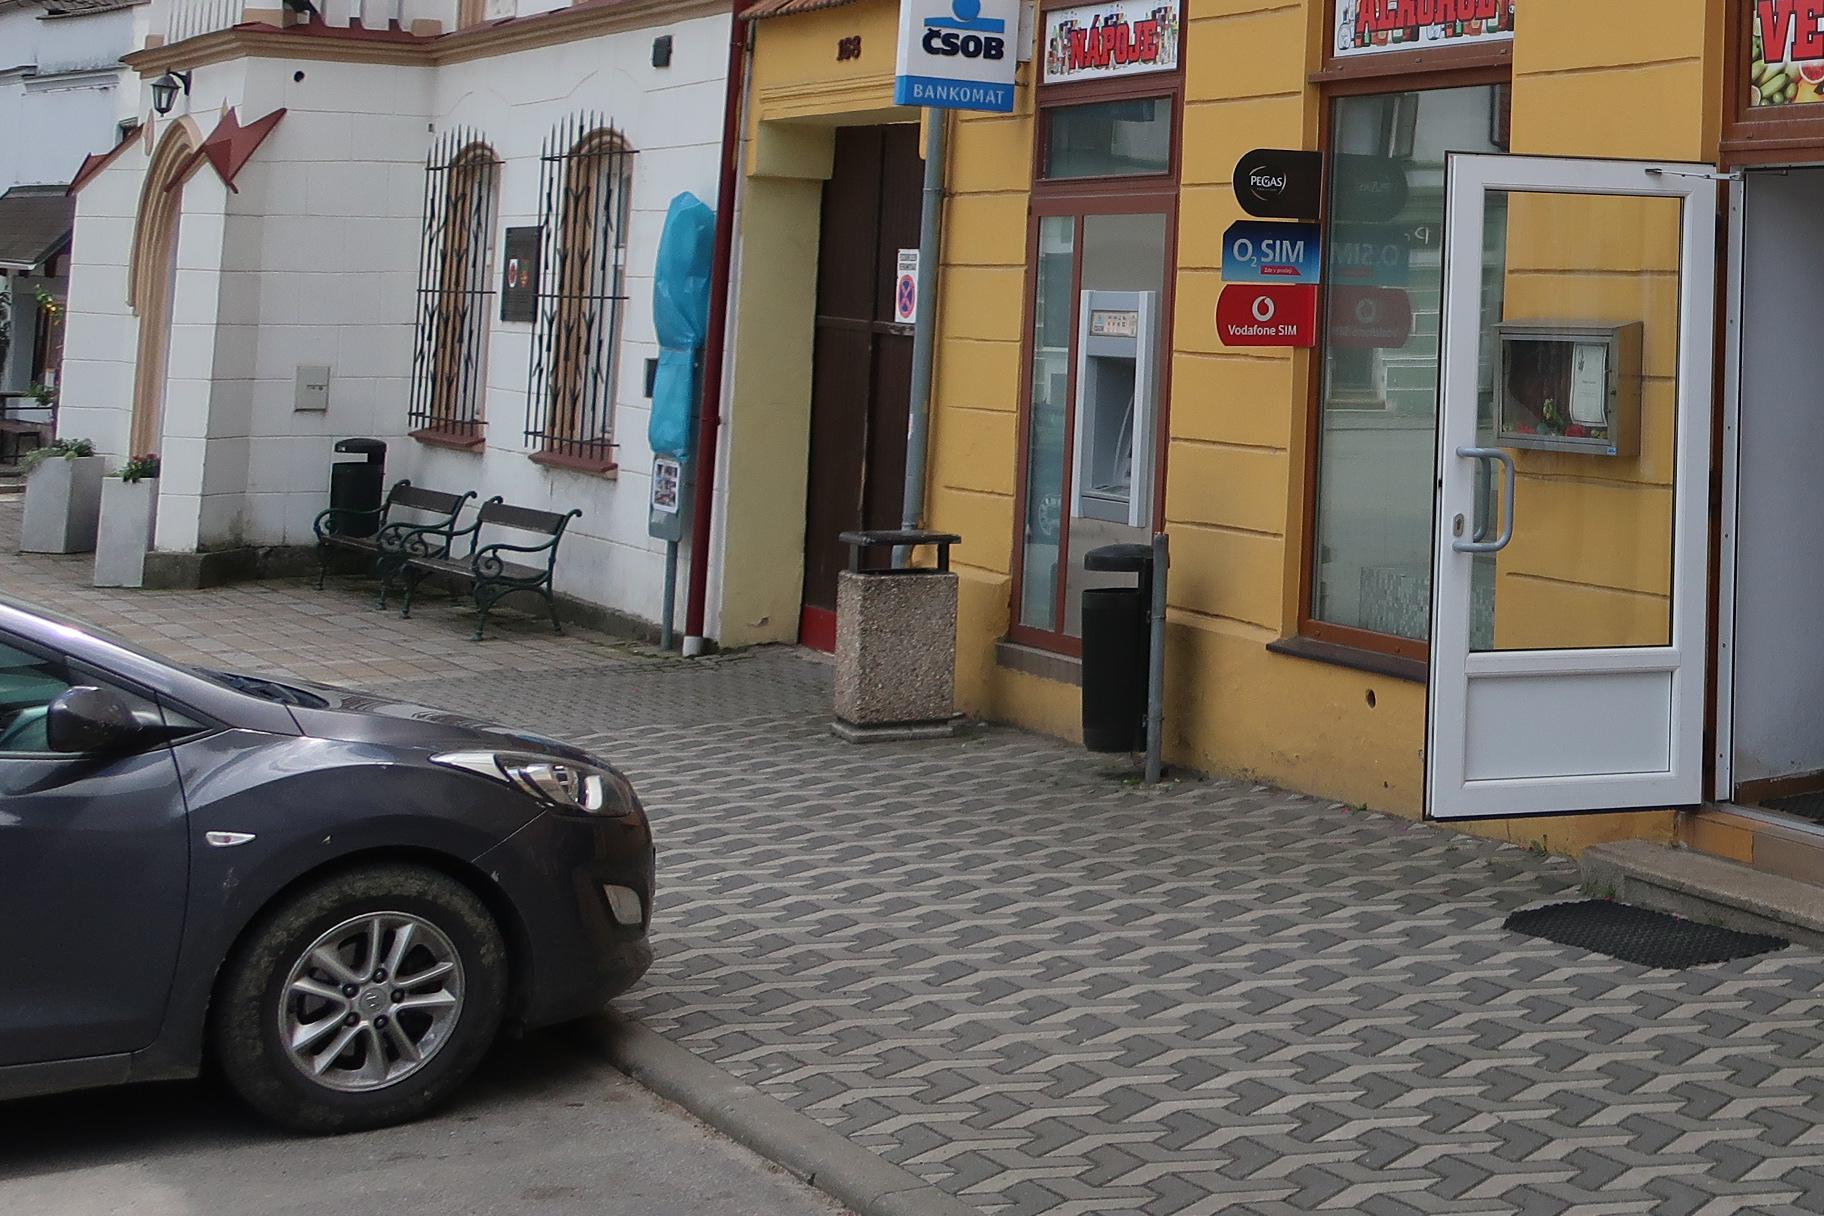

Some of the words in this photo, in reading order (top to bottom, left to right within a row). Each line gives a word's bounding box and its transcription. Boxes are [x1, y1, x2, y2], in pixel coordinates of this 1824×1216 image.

[922, 27, 1005, 60] ČSOB
[1068, 14, 1159, 69] NÁPOJE
[913, 83, 1005, 105] BANKOMAT
[1250, 175, 1283, 188] PEGAS
[1261, 239, 1304, 263] SIM
[1228, 325, 1276, 336] Vodafone
[1278, 325, 1297, 335] SIM
